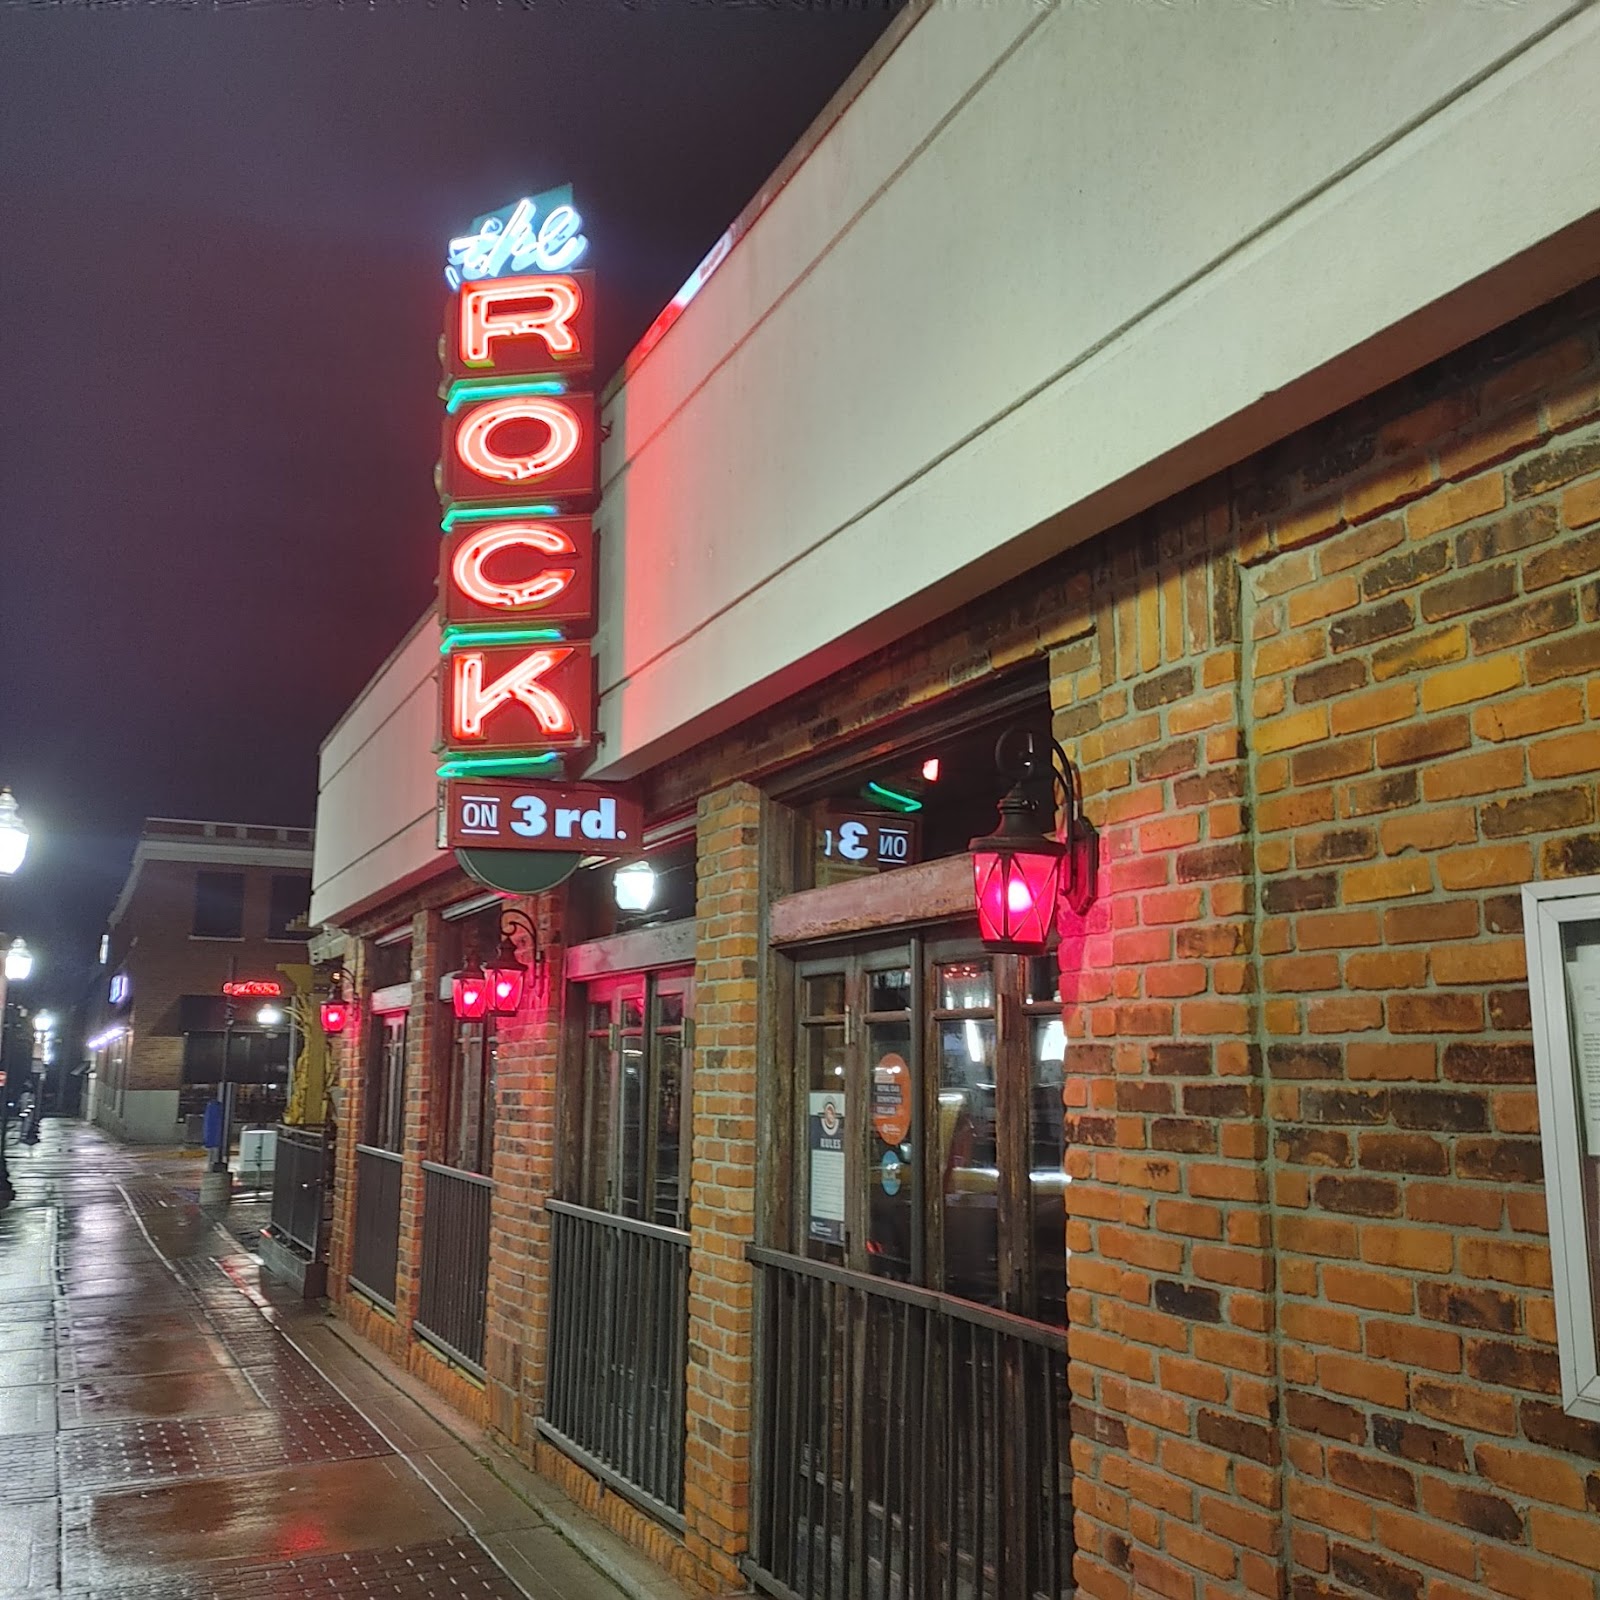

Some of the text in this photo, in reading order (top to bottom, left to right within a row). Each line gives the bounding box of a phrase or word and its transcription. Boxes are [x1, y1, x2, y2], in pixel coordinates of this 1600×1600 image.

[447, 198, 588, 281] the
[452, 275, 583, 742] ROCK
[462, 795, 627, 840] ON 3rd.
[820, 1138, 841, 1150] RULES
